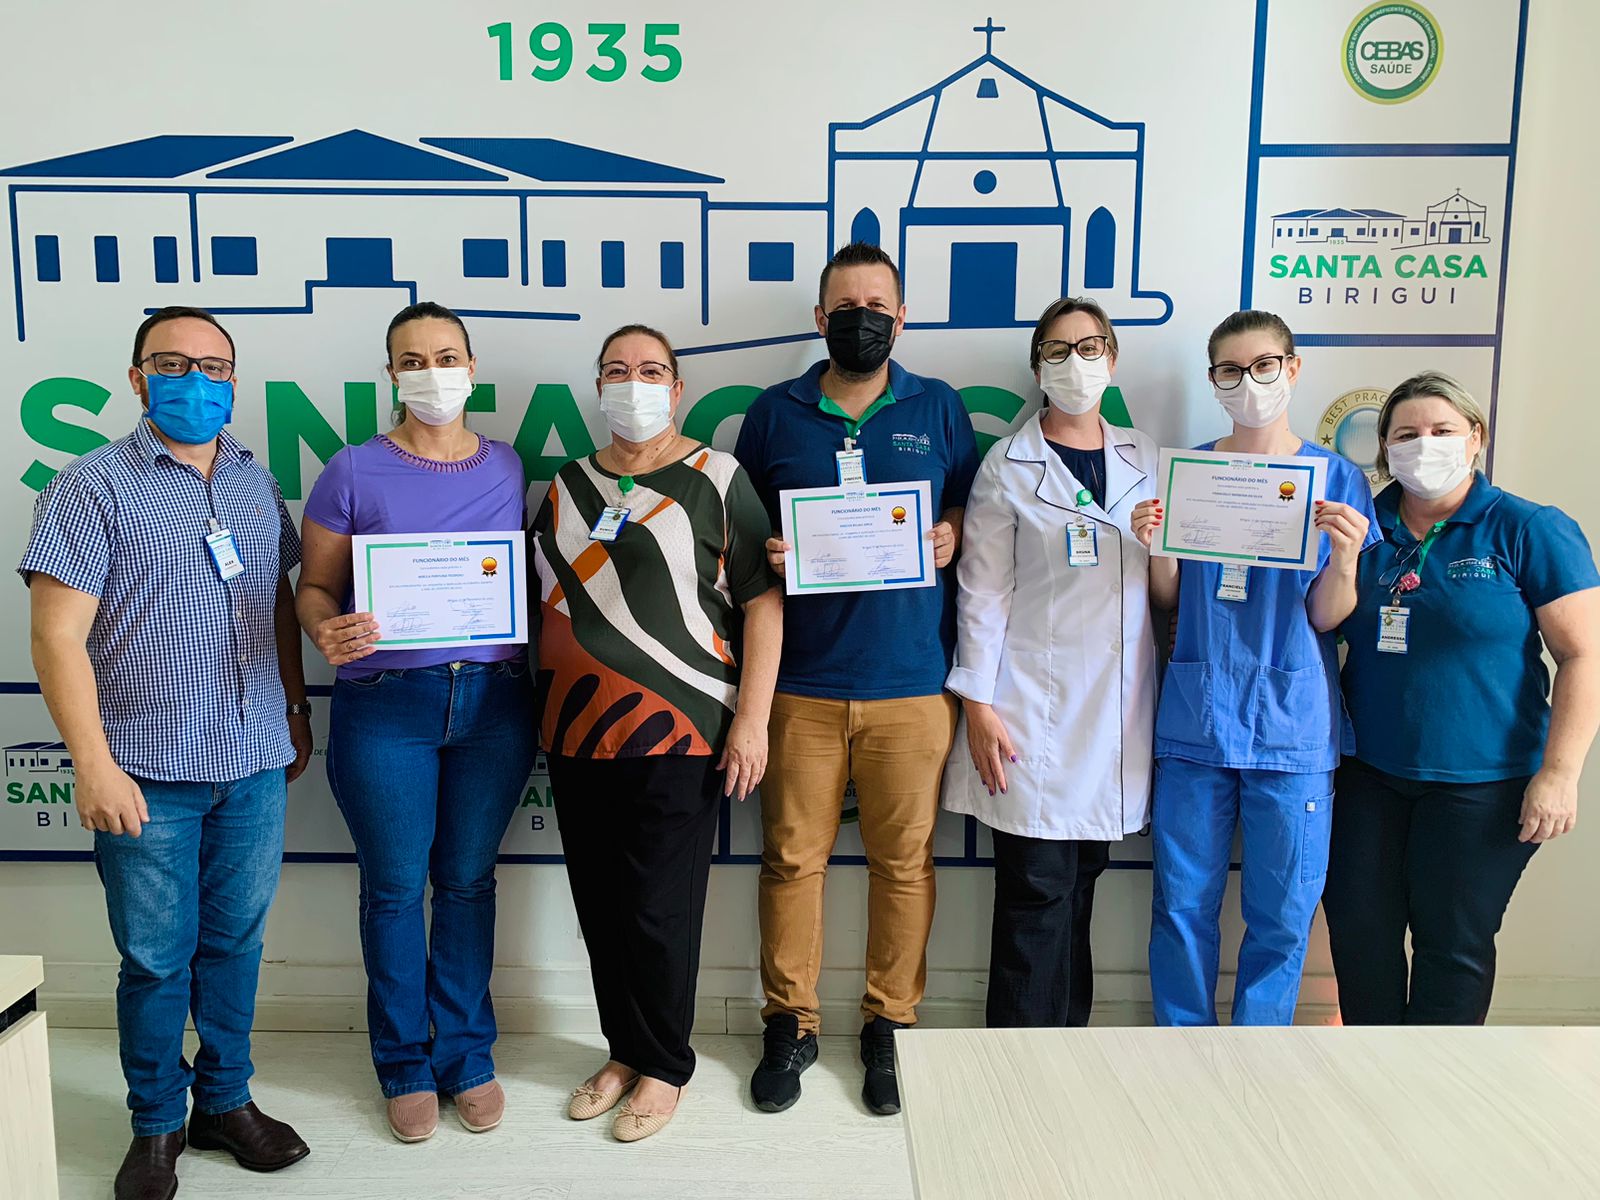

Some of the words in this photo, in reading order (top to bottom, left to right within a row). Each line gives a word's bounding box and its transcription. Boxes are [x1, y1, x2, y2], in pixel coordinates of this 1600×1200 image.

[486, 22, 683, 82] 1935
[1360, 41, 1424, 61] CEBAS
[1370, 61, 1412, 74] SAÚDE
[1268, 254, 1382, 279] SANTA
[1394, 254, 1488, 279] CASA
[1298, 287, 1455, 304] BIRIGUI
[1325, 399, 1348, 425] BEST
[20, 376, 598, 502] SNA
[7, 782, 75, 804] SAN
